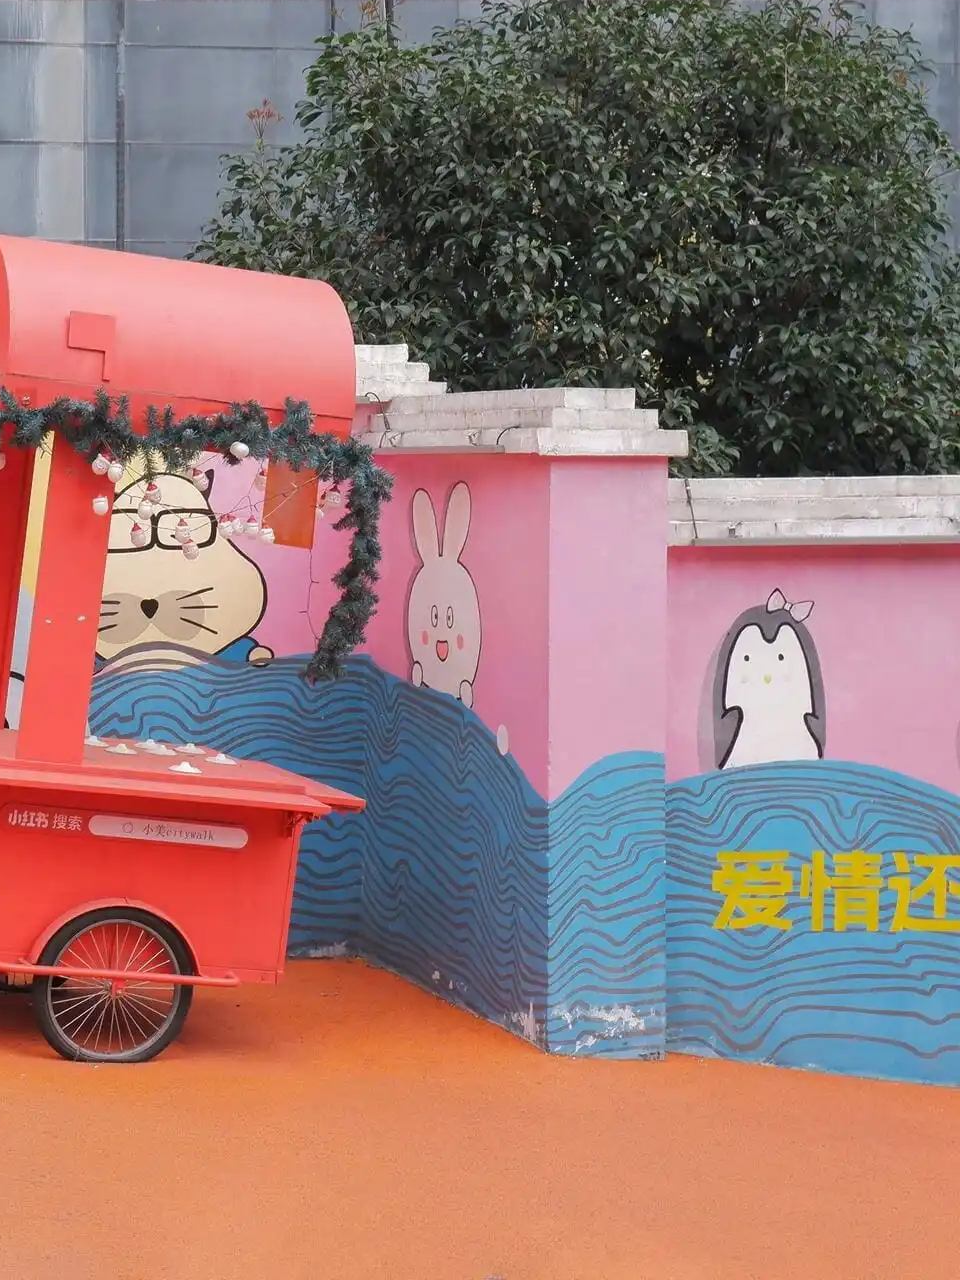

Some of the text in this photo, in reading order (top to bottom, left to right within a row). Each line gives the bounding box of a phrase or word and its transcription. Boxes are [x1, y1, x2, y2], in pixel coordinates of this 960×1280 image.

[8, 809, 49, 828] 小红书
[52, 813, 82, 832] 搜索
[712, 849, 960, 932] 爱情还
